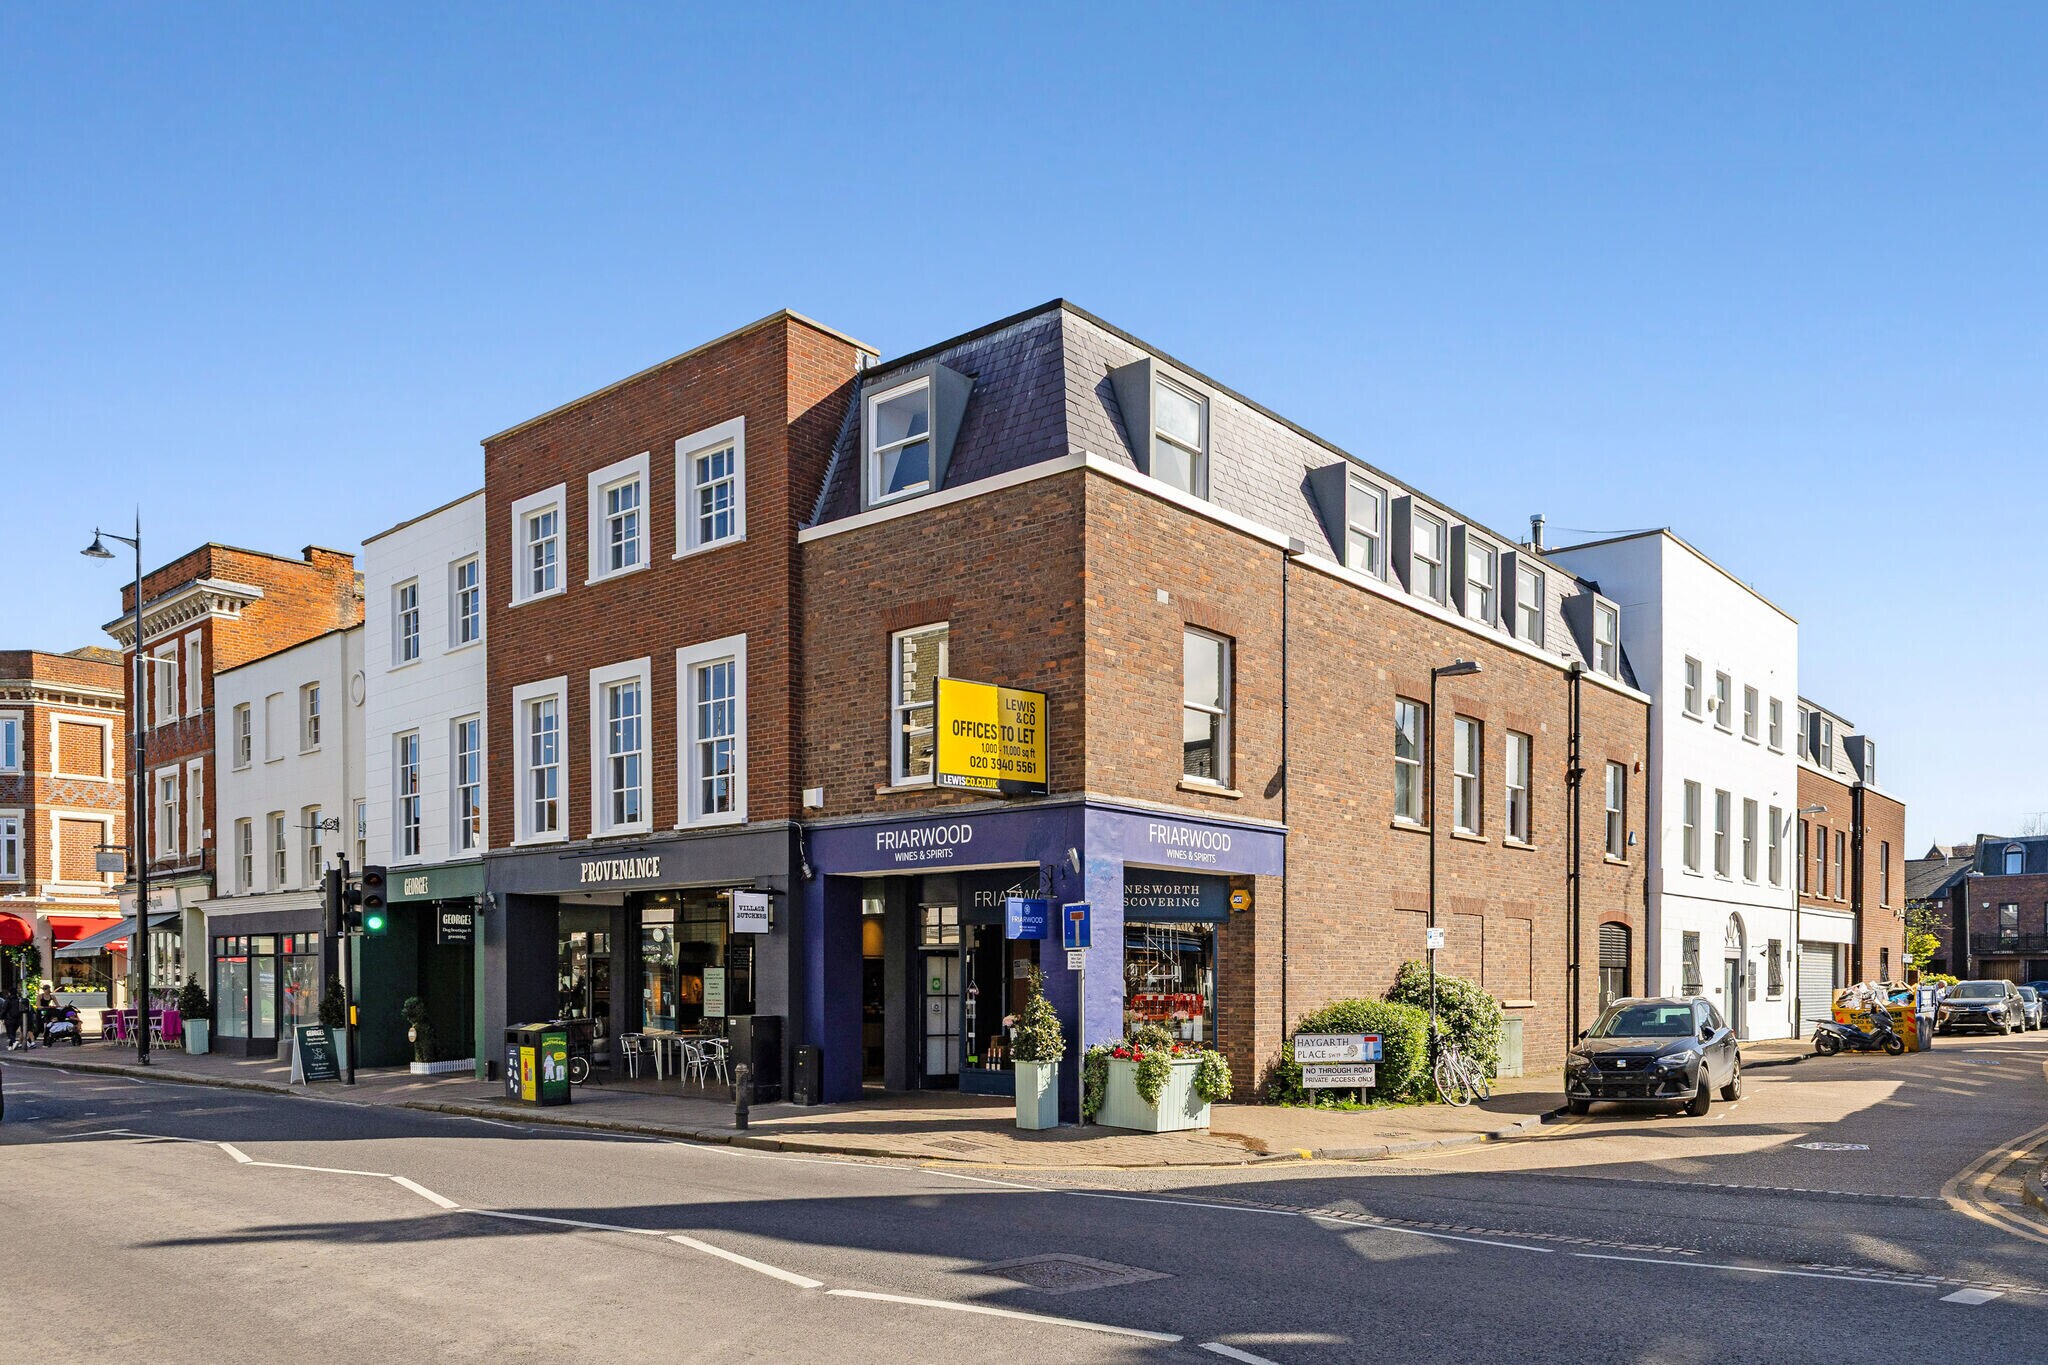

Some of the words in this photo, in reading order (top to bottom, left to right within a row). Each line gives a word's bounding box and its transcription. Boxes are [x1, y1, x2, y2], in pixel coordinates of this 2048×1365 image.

[1005, 698, 1036, 713] LEWIS
[1016, 712, 1036, 726] &CO
[952, 719, 998, 740] OFFICES
[1000, 725, 1014, 742] TO
[1017, 727, 1035, 745] LET
[981, 743, 998, 754] 1,000
[1003, 745, 1020, 756] 11,000
[1021, 749, 1029, 759] sq
[1029, 748, 1036, 759] ft
[969, 755, 988, 769] 020
[990, 757, 1014, 772] 3940
[1016, 760, 1037, 774] 5561
[943, 774, 998, 789] LEWISCO.CO.UK
[876, 824, 973, 851] FRIARWOOD
[1149, 823, 1232, 851] FRIARWOOD
[894, 851, 918, 862] WINES
[919, 850, 925, 860] &
[926, 848, 953, 859] SPIRITS
[1166, 849, 1187, 860] WINES
[1188, 852, 1193, 861] &
[1194, 852, 1217, 864] SPIRITS
[580, 856, 661, 883] PROVENANCE
[738, 904, 765, 912] VILLAGE
[736, 912, 767, 920] BUTCHERS
[1011, 915, 1043, 924] FRIARWOOD
[1297, 1038, 1349, 1047] HAYGARTH
[1297, 1050, 1326, 1059] PLACE
[1305, 1067, 1316, 1075] NO
